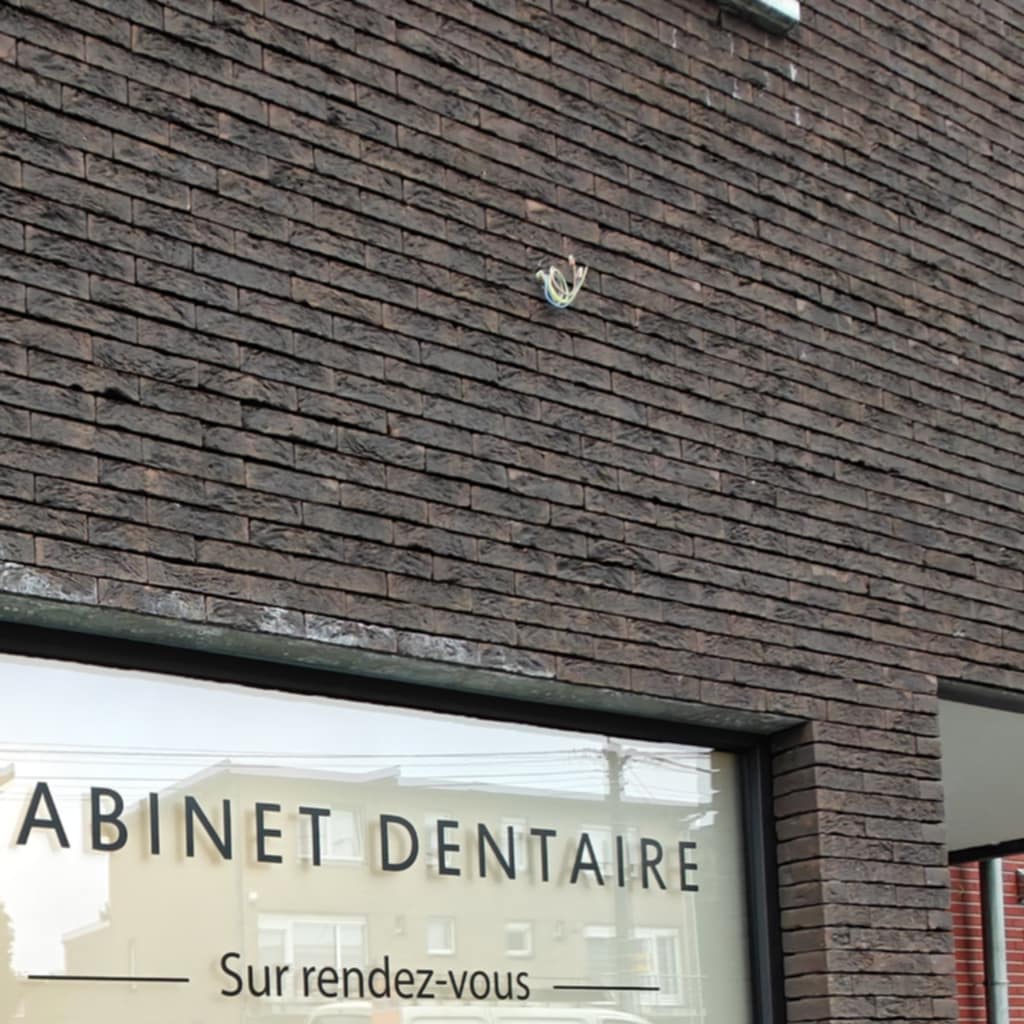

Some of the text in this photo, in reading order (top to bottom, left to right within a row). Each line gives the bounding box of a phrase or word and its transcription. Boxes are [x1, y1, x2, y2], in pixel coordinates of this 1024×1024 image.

[380, 813, 700, 893] DENTAIRE
[219, 952, 531, 1001] Sur rendez-vous
